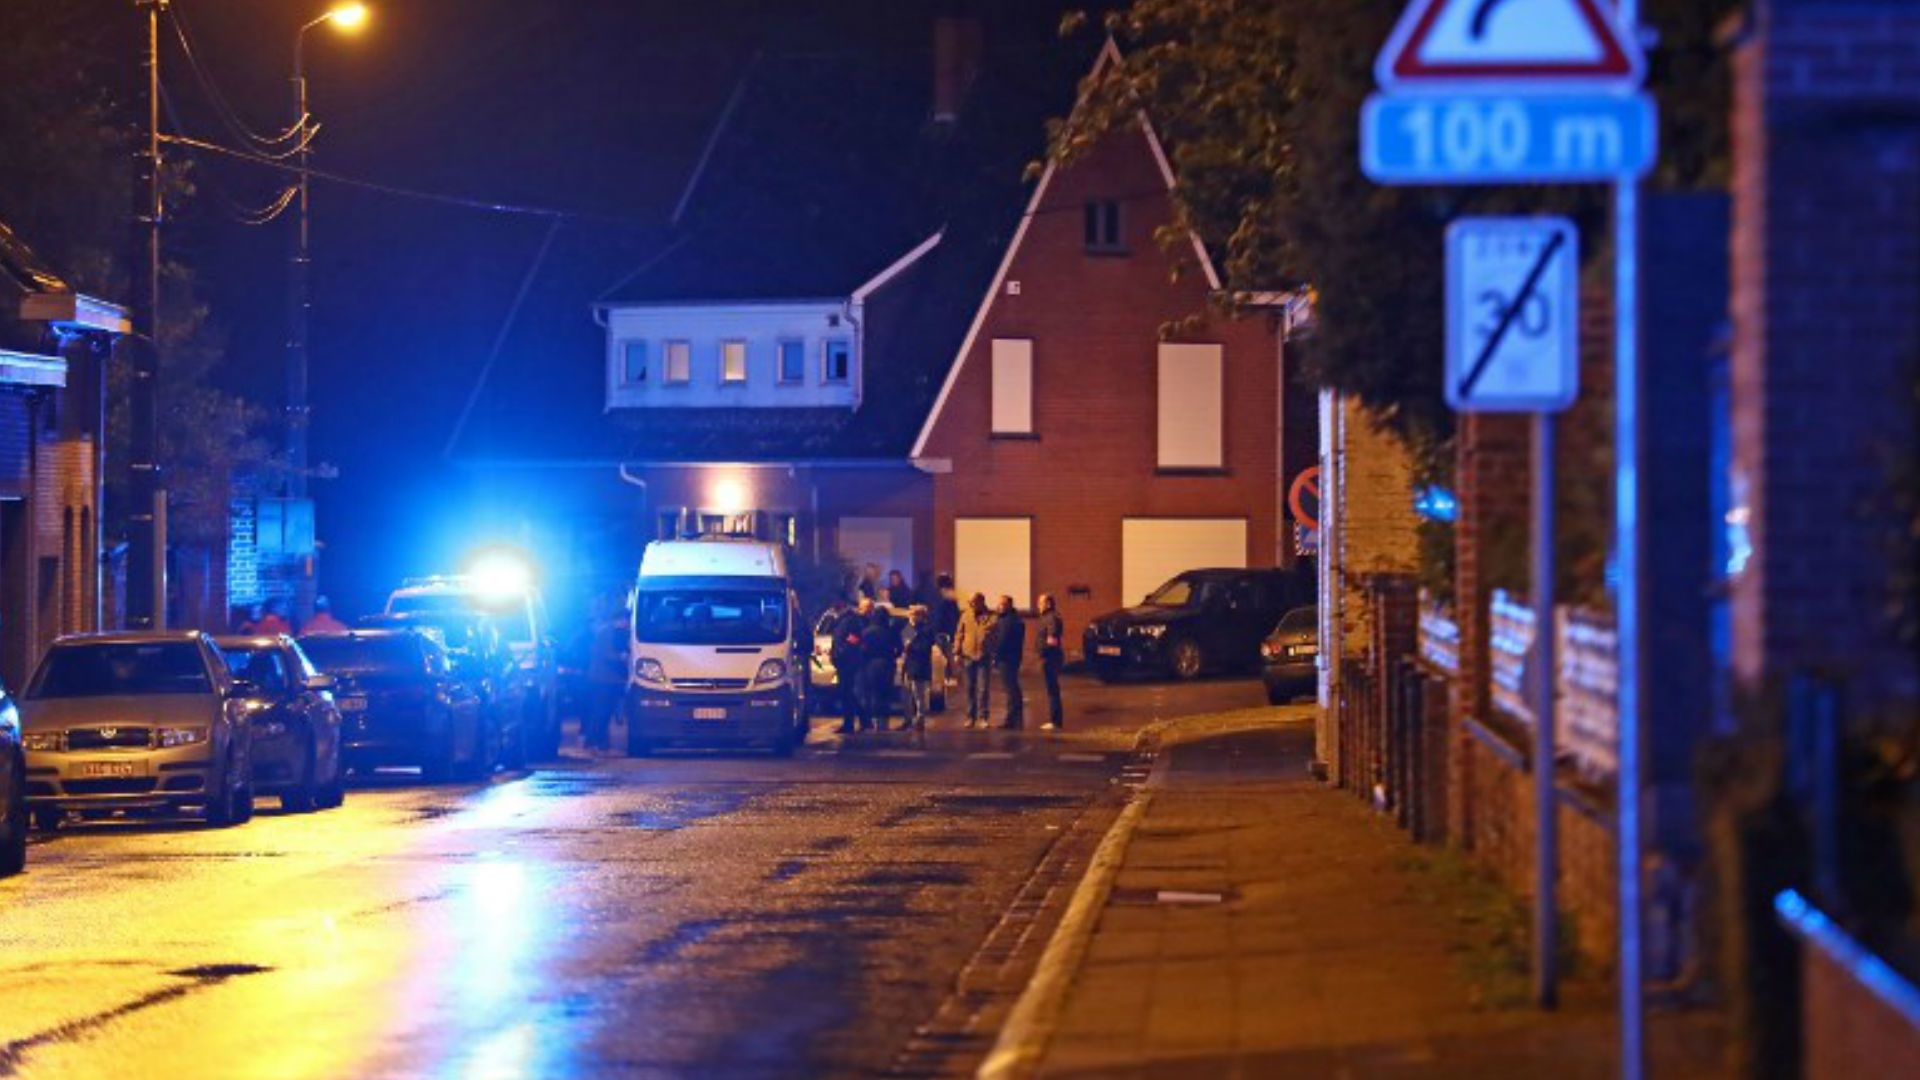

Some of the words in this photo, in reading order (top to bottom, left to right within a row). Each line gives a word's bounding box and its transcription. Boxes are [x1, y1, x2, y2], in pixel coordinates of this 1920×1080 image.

[1400, 101, 1530, 172] 100
[1552, 117, 1622, 172] m
[1476, 289, 1551, 339] 30
